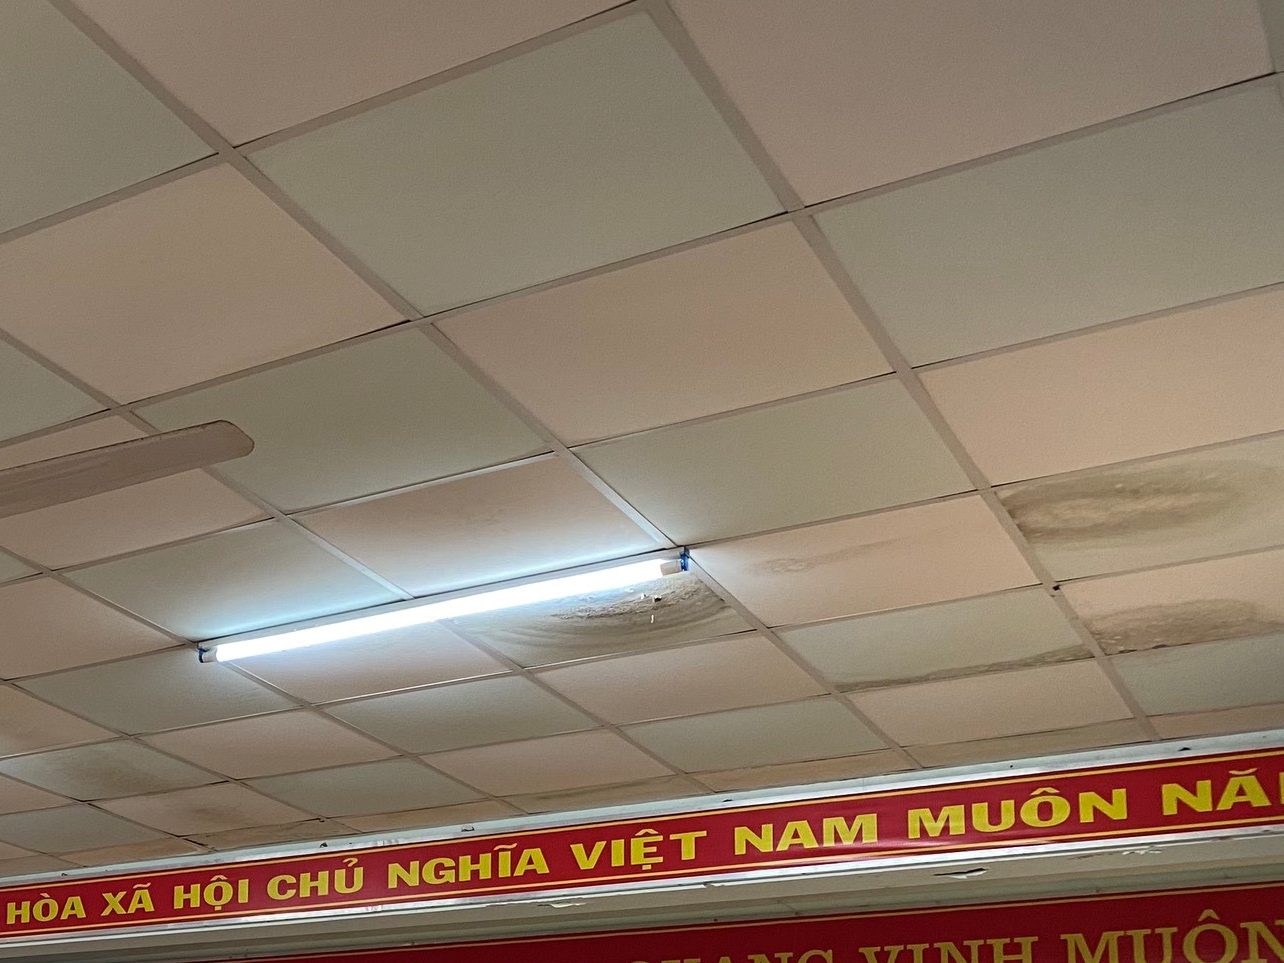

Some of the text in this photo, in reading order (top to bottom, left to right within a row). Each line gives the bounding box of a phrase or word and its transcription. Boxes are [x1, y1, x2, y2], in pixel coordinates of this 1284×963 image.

[6, 890, 86, 925] HÒA
[101, 883, 154, 917] XÃ
[173, 876, 249, 911] HỘI
[267, 859, 364, 900] CHỦ
[387, 843, 550, 889] NGHĨA
[570, 828, 707, 871] VIỆT
[734, 813, 878, 854] NAM
[907, 787, 1127, 839] MUÔN
[1161, 767, 1284, 814] NĂ
